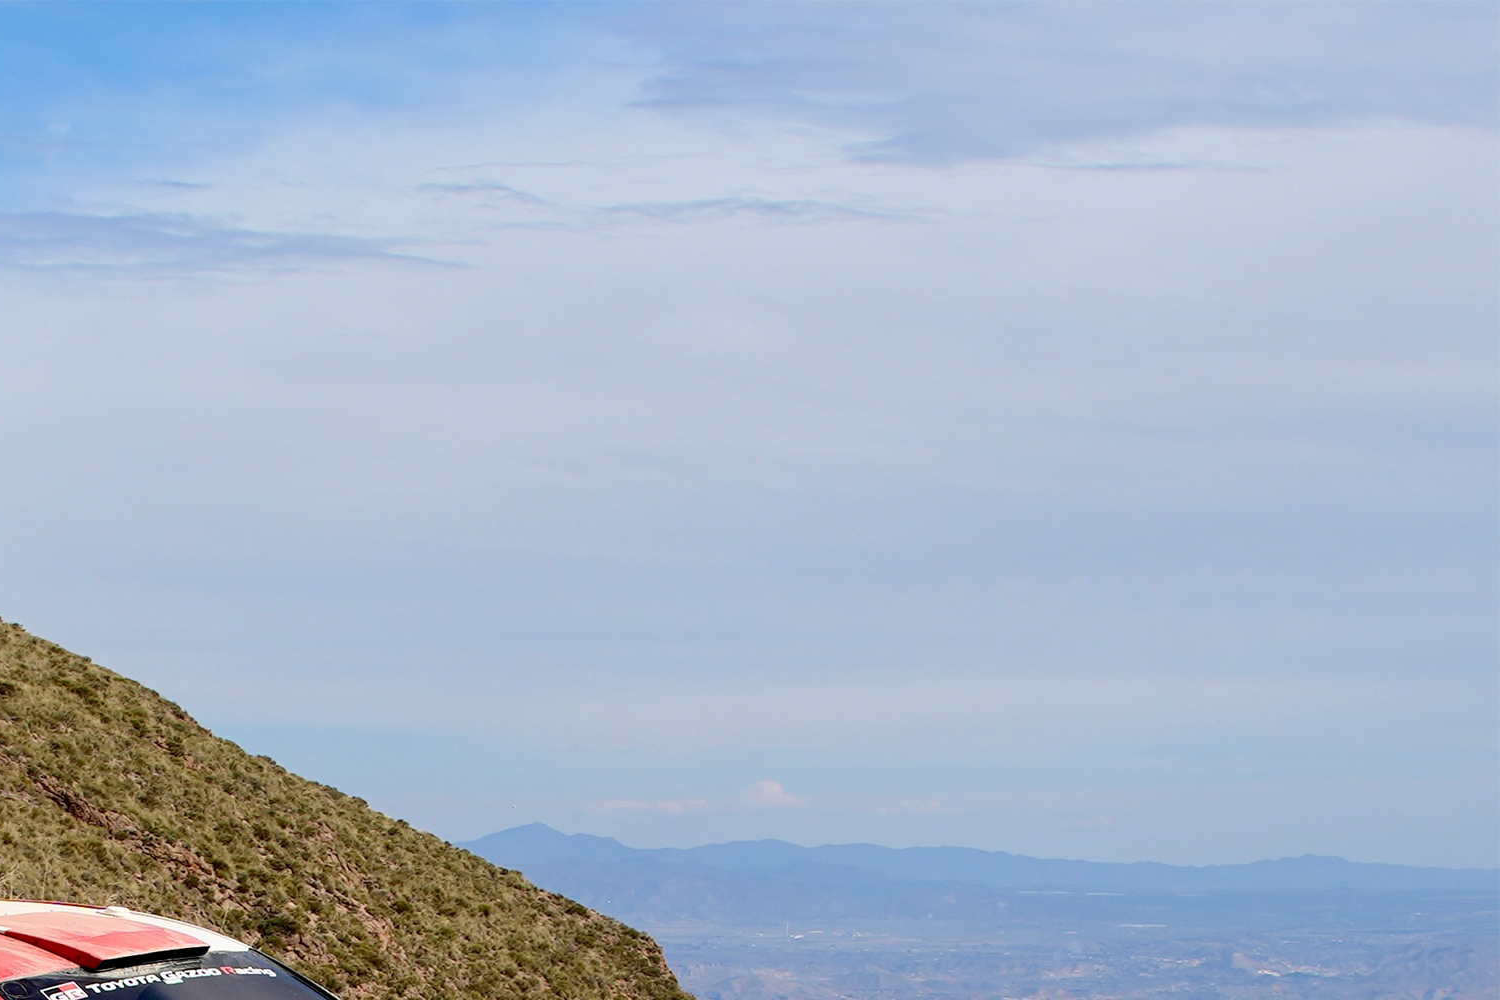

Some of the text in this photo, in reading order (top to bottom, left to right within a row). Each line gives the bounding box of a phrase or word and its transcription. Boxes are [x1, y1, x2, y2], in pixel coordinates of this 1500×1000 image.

[85, 974, 161, 994] TOYOTA
[159, 968, 222, 983] GAZOO
[220, 966, 277, 978] Racing
